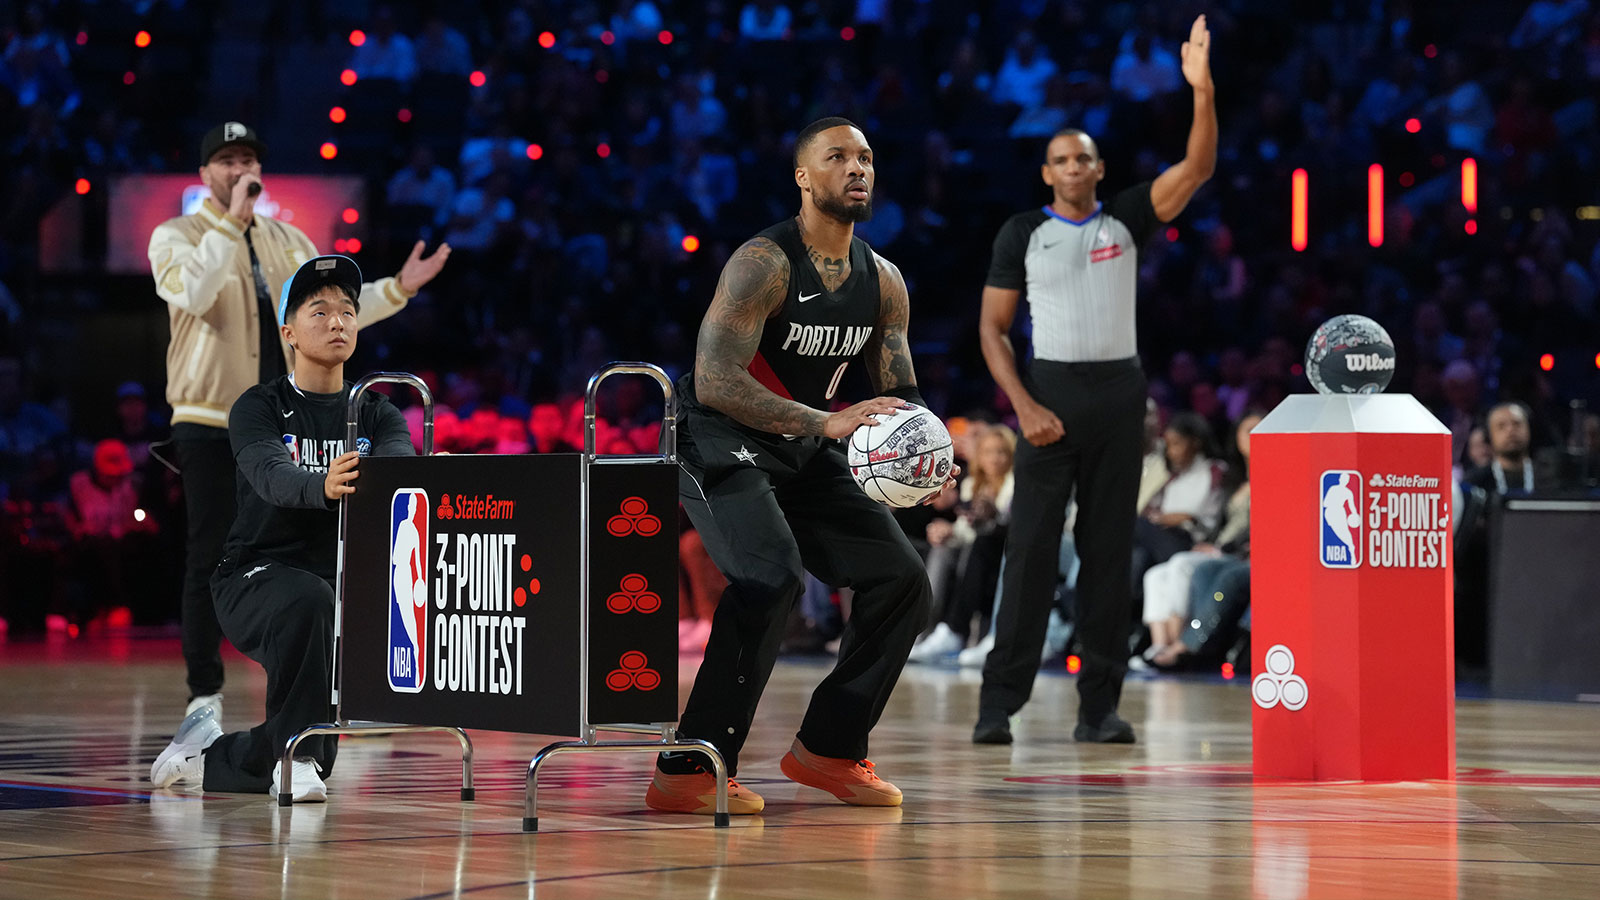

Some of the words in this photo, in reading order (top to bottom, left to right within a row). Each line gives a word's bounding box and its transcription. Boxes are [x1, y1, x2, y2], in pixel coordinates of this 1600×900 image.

[825, 361, 848, 400] 0
[322, 439, 347, 466] STA
[1369, 492, 1441, 530] 3-POINT
[1326, 545, 1348, 562] NBA
[1369, 529, 1447, 568] CONTEST
[435, 533, 516, 611] 3-POINT
[393, 646, 412, 678] NBA
[434, 613, 526, 695] CONTEST
